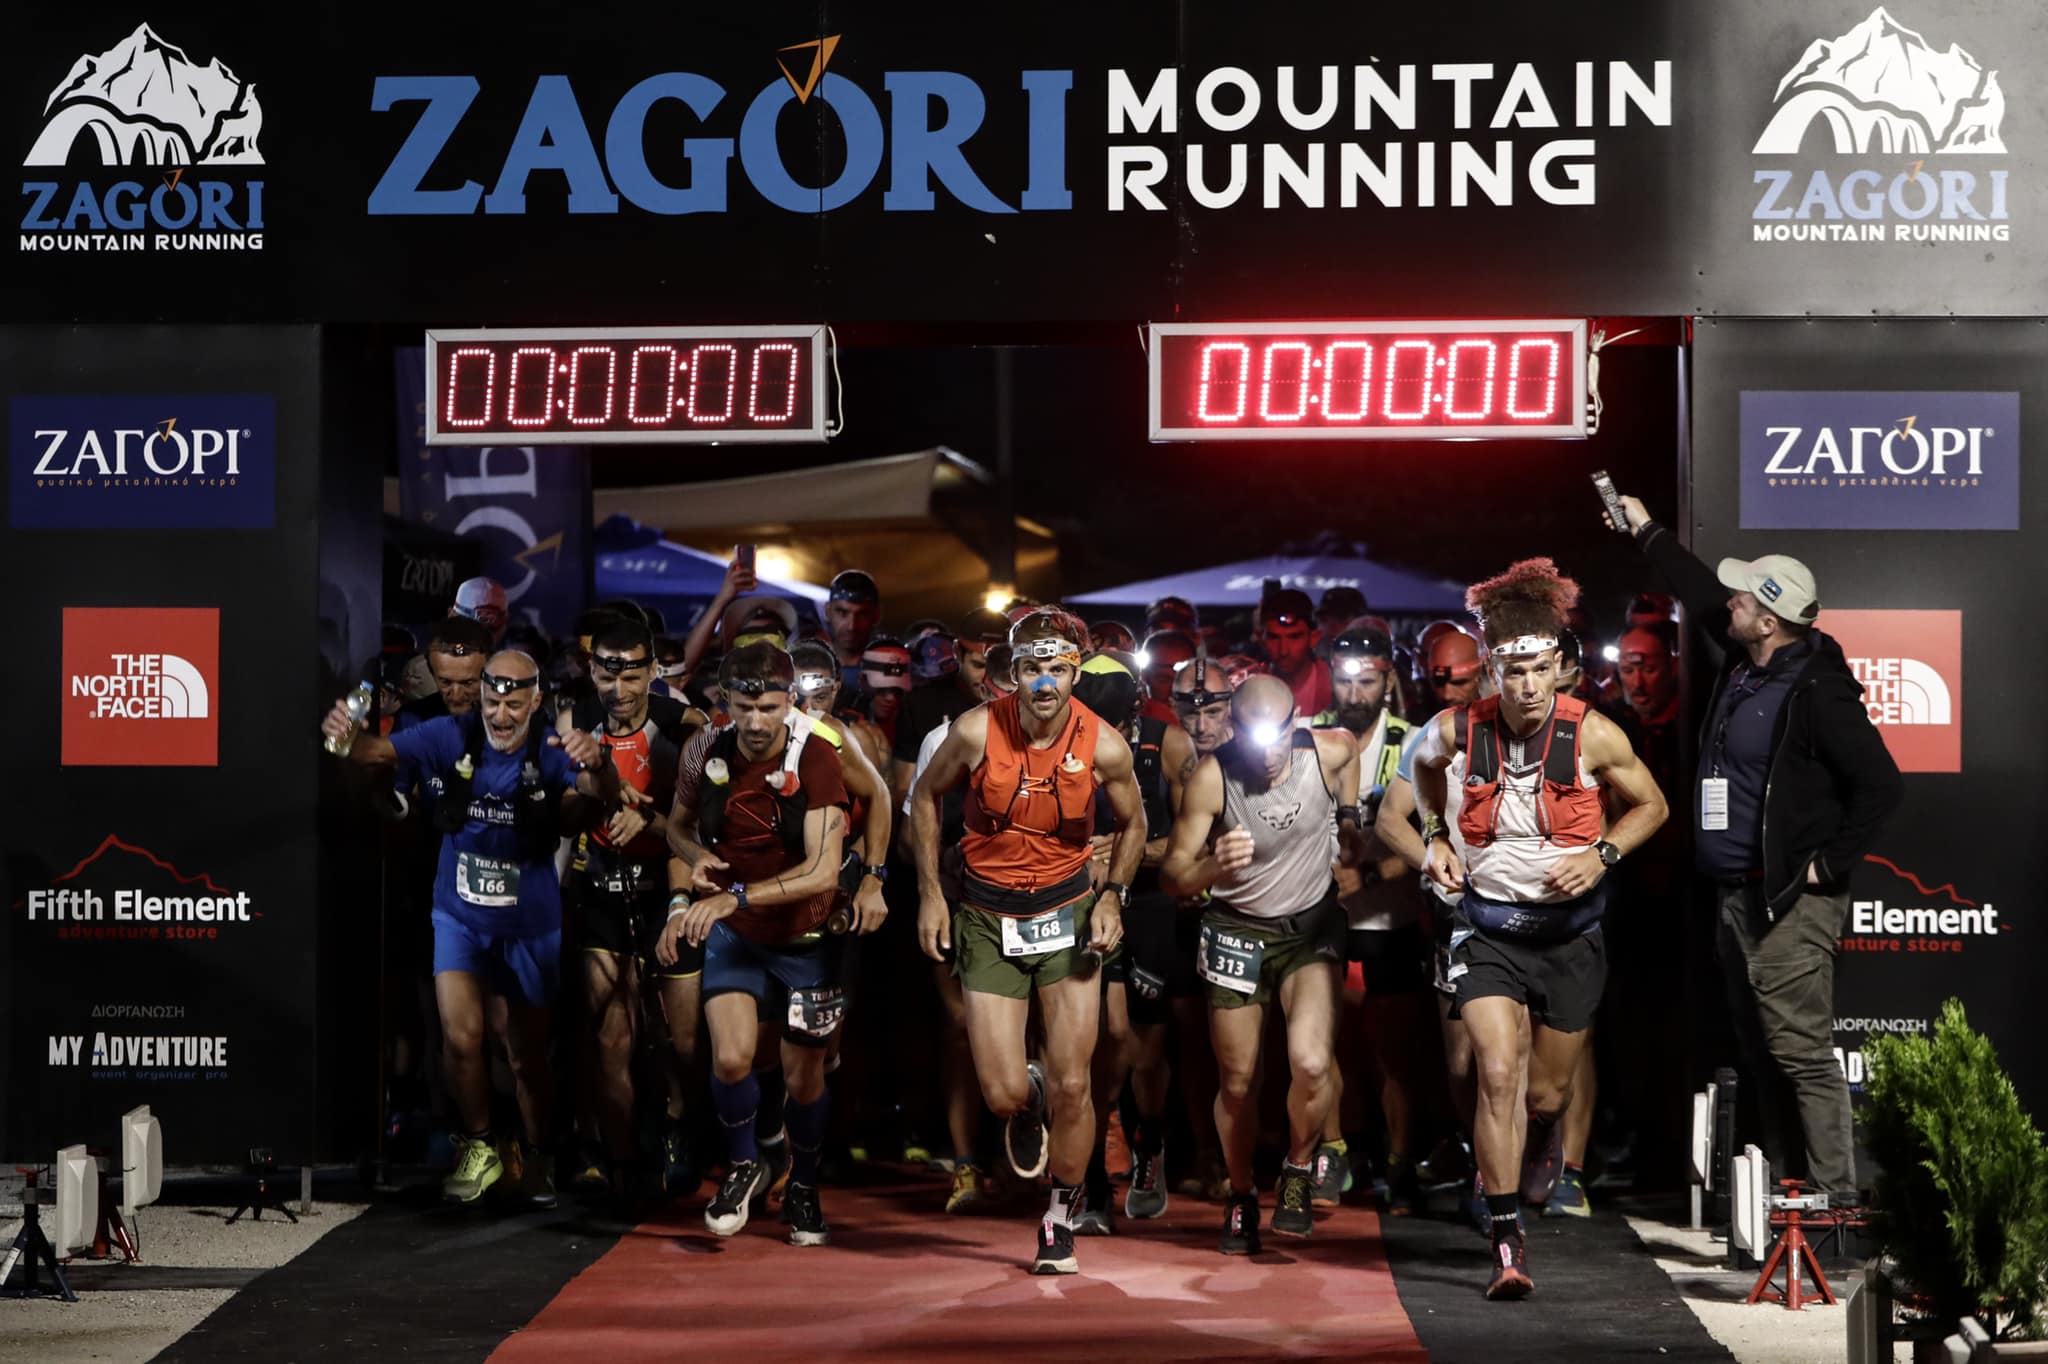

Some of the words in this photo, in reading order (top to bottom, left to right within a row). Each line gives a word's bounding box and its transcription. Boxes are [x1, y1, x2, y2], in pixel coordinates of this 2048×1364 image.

[1108, 60, 1672, 134] MOUNTAIN
[368, 67, 1073, 214] ZAGORI
[1108, 139, 1596, 211] RUNNING
[20, 179, 265, 230] ZAGORI
[1752, 169, 2009, 220] ZAGORI
[20, 235, 145, 251] MOUNTAIN
[155, 233, 263, 250] RUNNING
[1753, 224, 1885, 241] MOUNTAIN
[1895, 224, 2010, 241] RUNNING
[111, 654, 160, 675] THE
[1847, 658, 1900, 680] THE
[72, 675, 160, 697] NORTH
[97, 697, 160, 719] FACE
[474, 857, 499, 870] TERA
[477, 878, 505, 893] 166
[28, 889, 103, 920] Fifth
[114, 889, 251, 921] Element
[1853, 901, 1998, 934] Element
[58, 925, 159, 938] adventure
[165, 926, 218, 939] store
[1031, 919, 1062, 938] 168
[1217, 933, 1241, 949] TERA
[1907, 938, 1963, 952] store
[1215, 956, 1245, 976] 313
[91, 1005, 185, 1018] ΔΙΟΡΓΑΝΩΣΗ
[49, 1036, 84, 1066] MY
[91, 1032, 228, 1067] ADVENTURE
